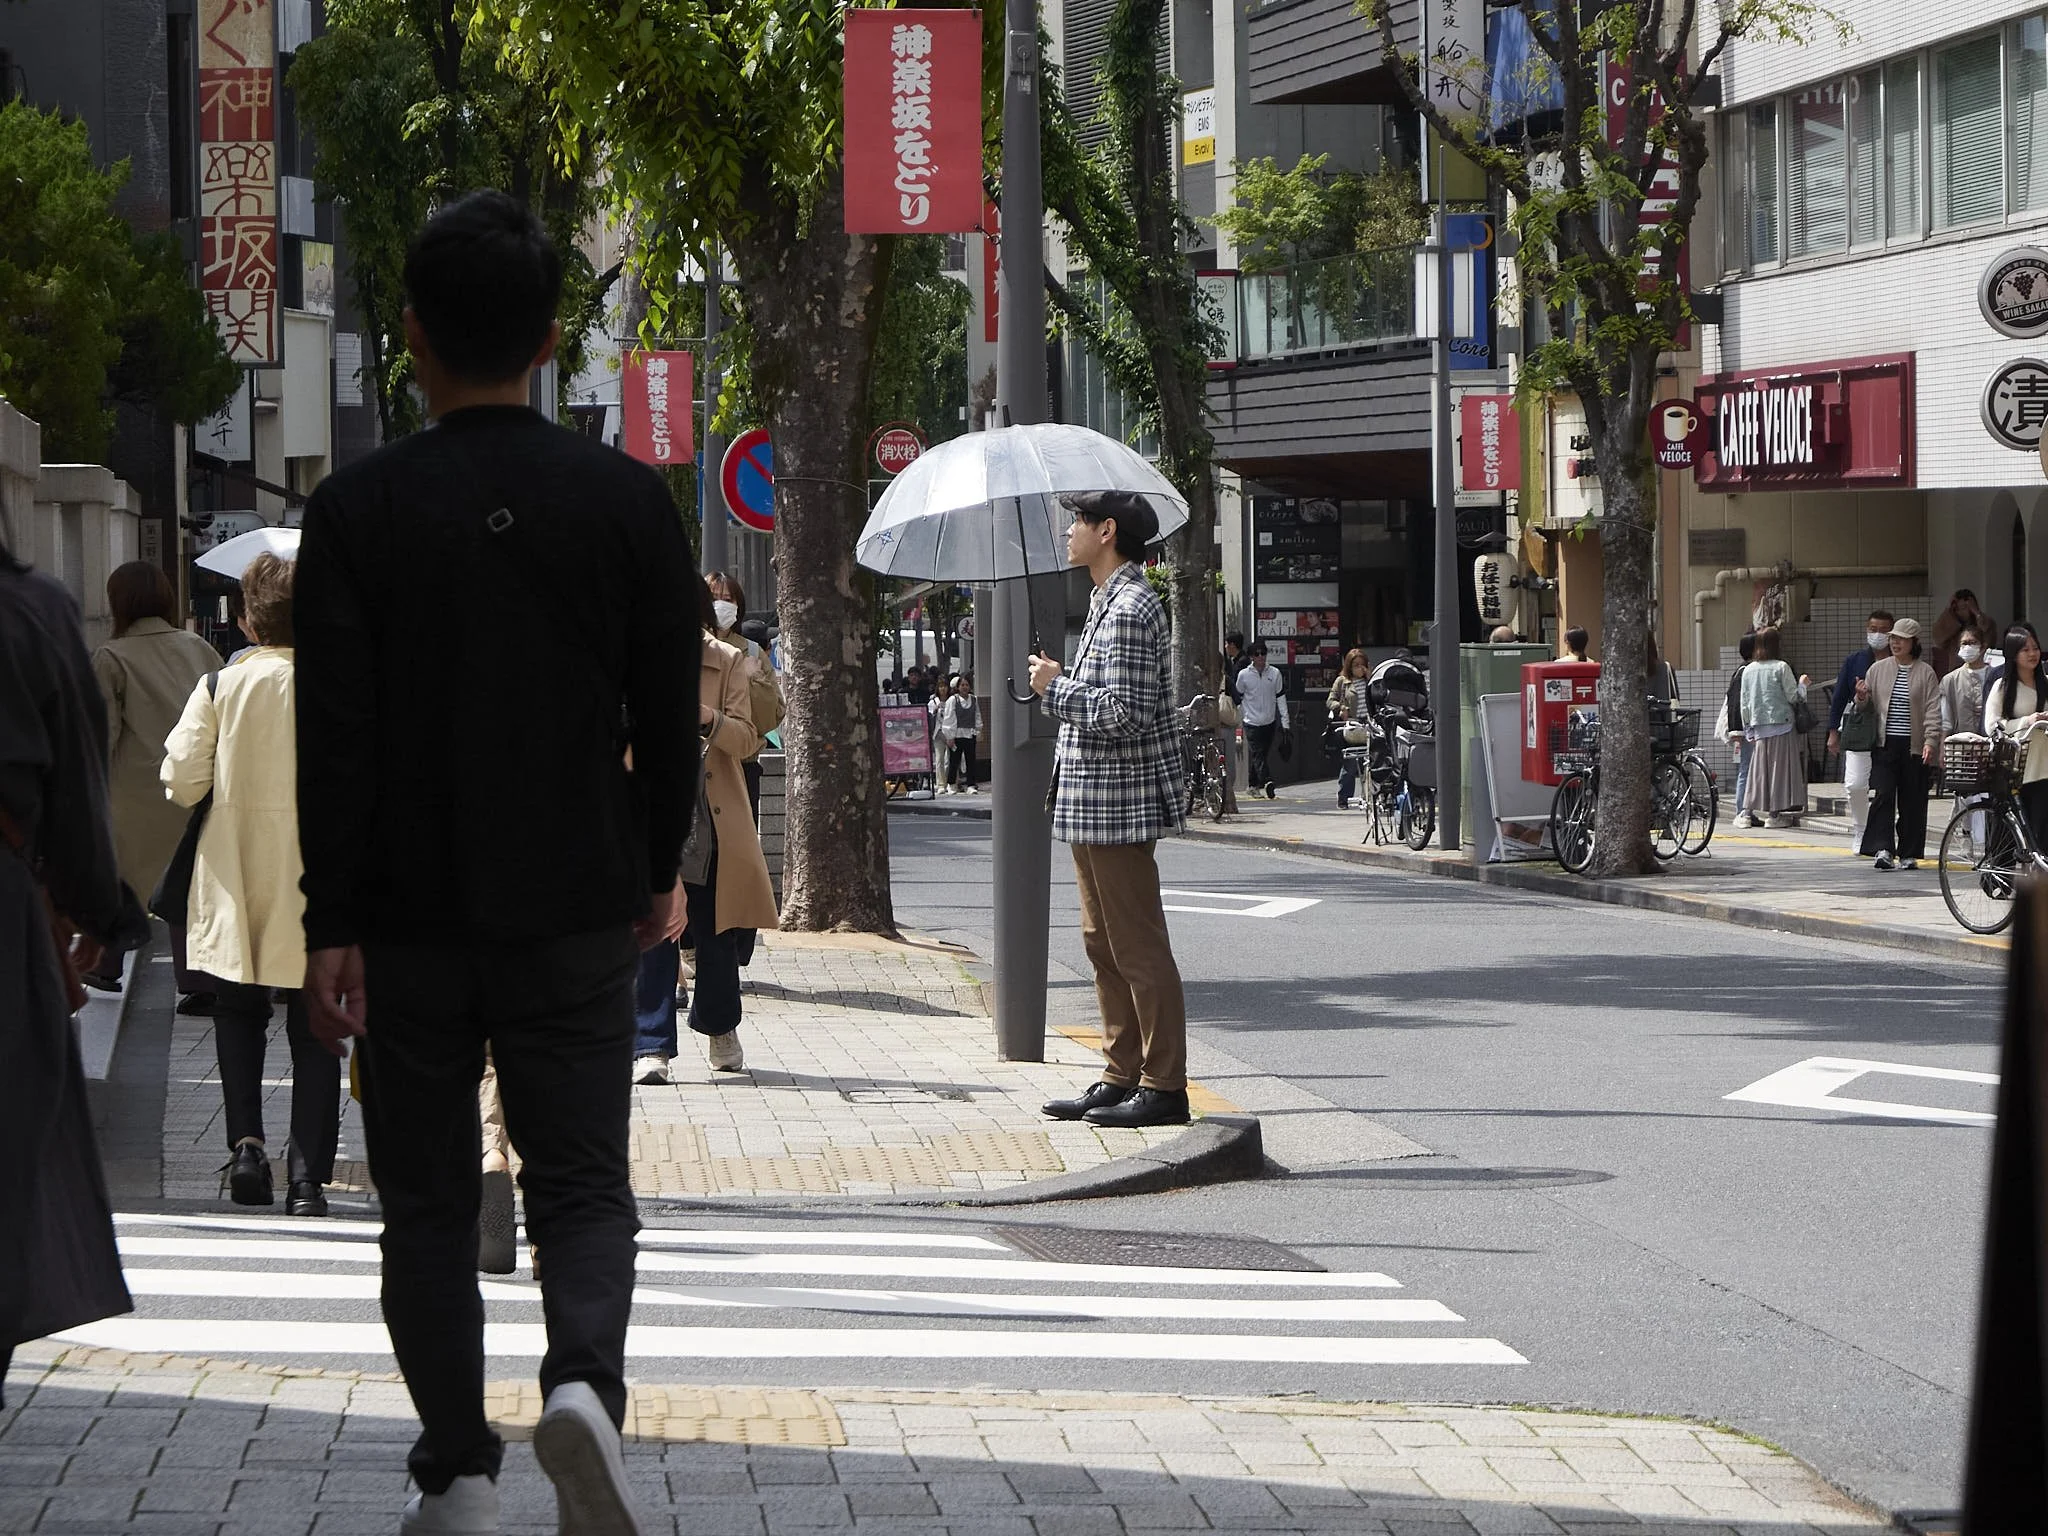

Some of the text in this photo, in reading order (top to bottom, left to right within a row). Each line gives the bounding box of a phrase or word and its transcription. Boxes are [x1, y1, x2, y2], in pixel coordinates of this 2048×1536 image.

[891, 24, 939, 226] 神楽坂をどり
[2002, 305, 2025, 319] WINE
[647, 358, 672, 460] 神楽坂をどり
[1720, 386, 1813, 467] CAFFE VELOCE
[881, 443, 917, 461] 消火栓
[1481, 401, 1502, 487] 神楽坂をどり
[1660, 451, 1692, 463] VELOCE
[1667, 443, 1684, 451] CAFFE
[1481, 562, 1501, 619] お任せ料理
